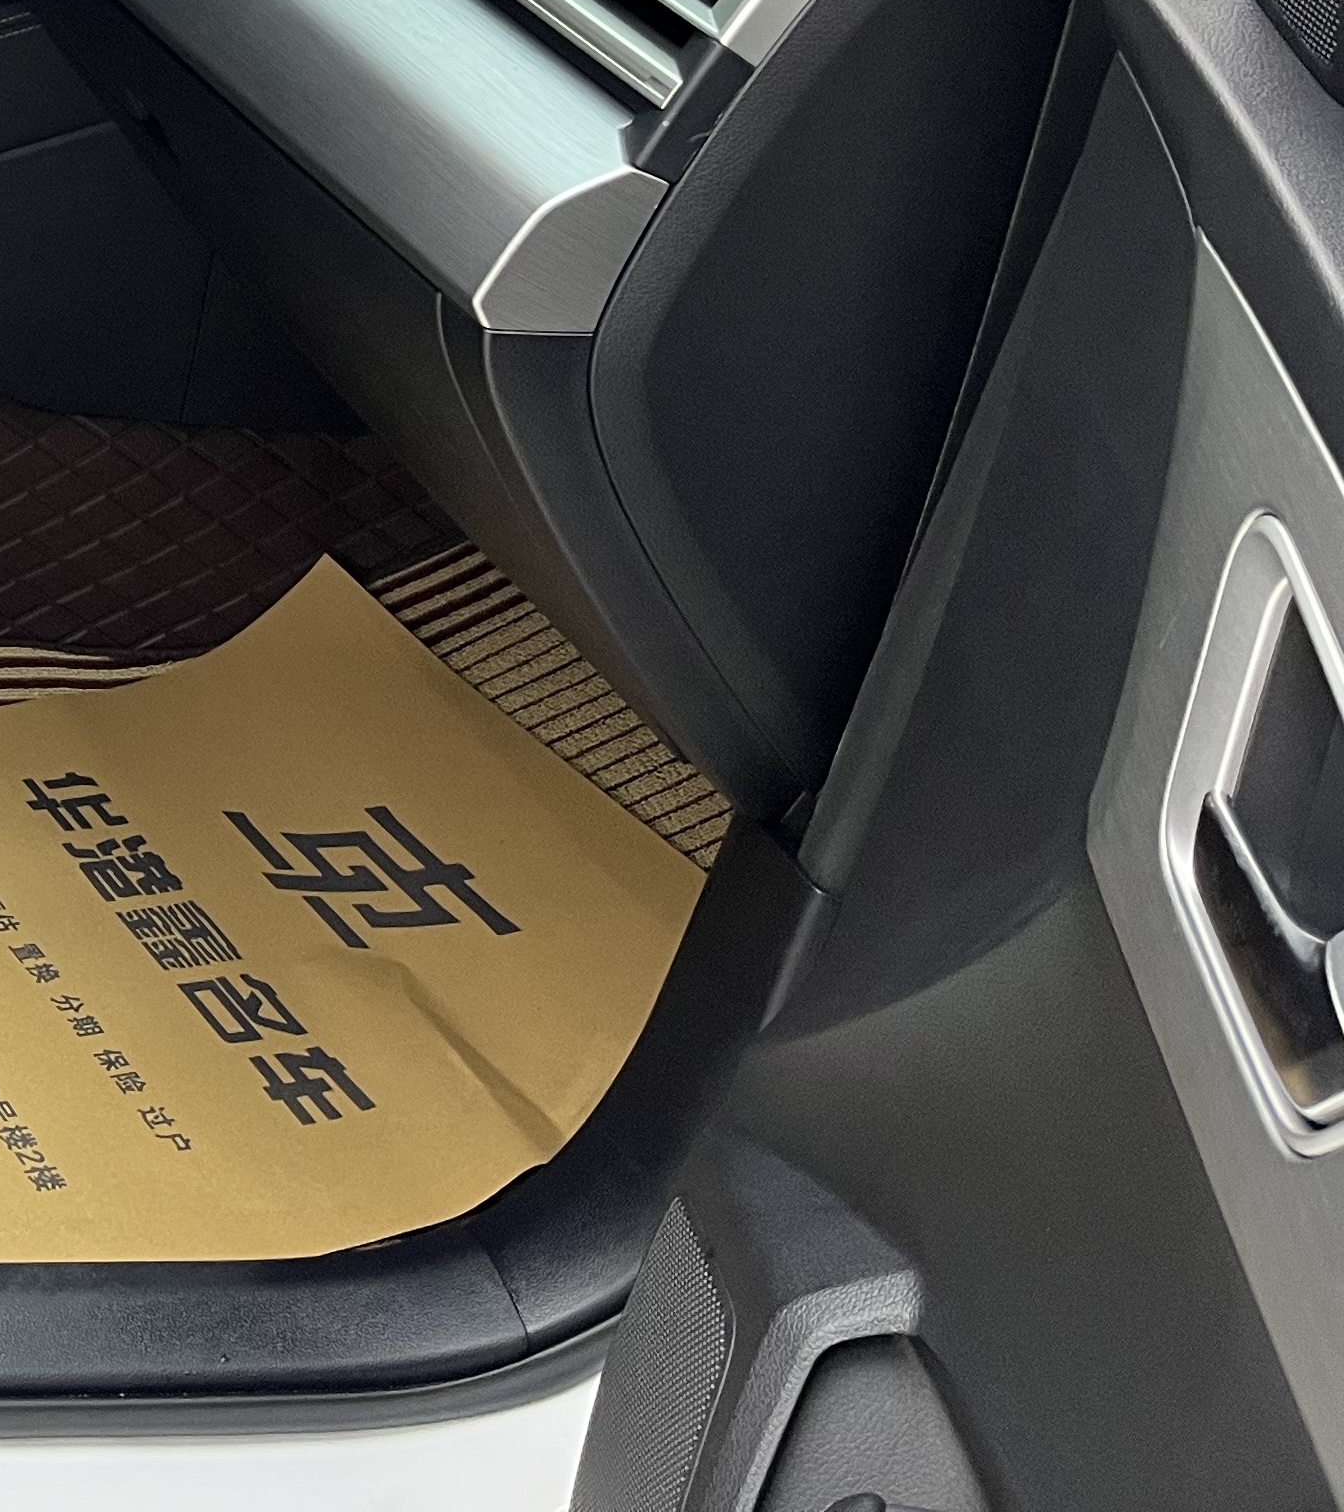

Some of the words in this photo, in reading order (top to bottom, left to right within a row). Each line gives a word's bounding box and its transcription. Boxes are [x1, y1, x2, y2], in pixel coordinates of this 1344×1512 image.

[9, 943, 61, 984] 置换
[50, 994, 105, 1038] 分期
[94, 1049, 147, 1095] 保险
[137, 1106, 192, 1152] 过户
[22, 772, 377, 1126] 华港鑫名车
